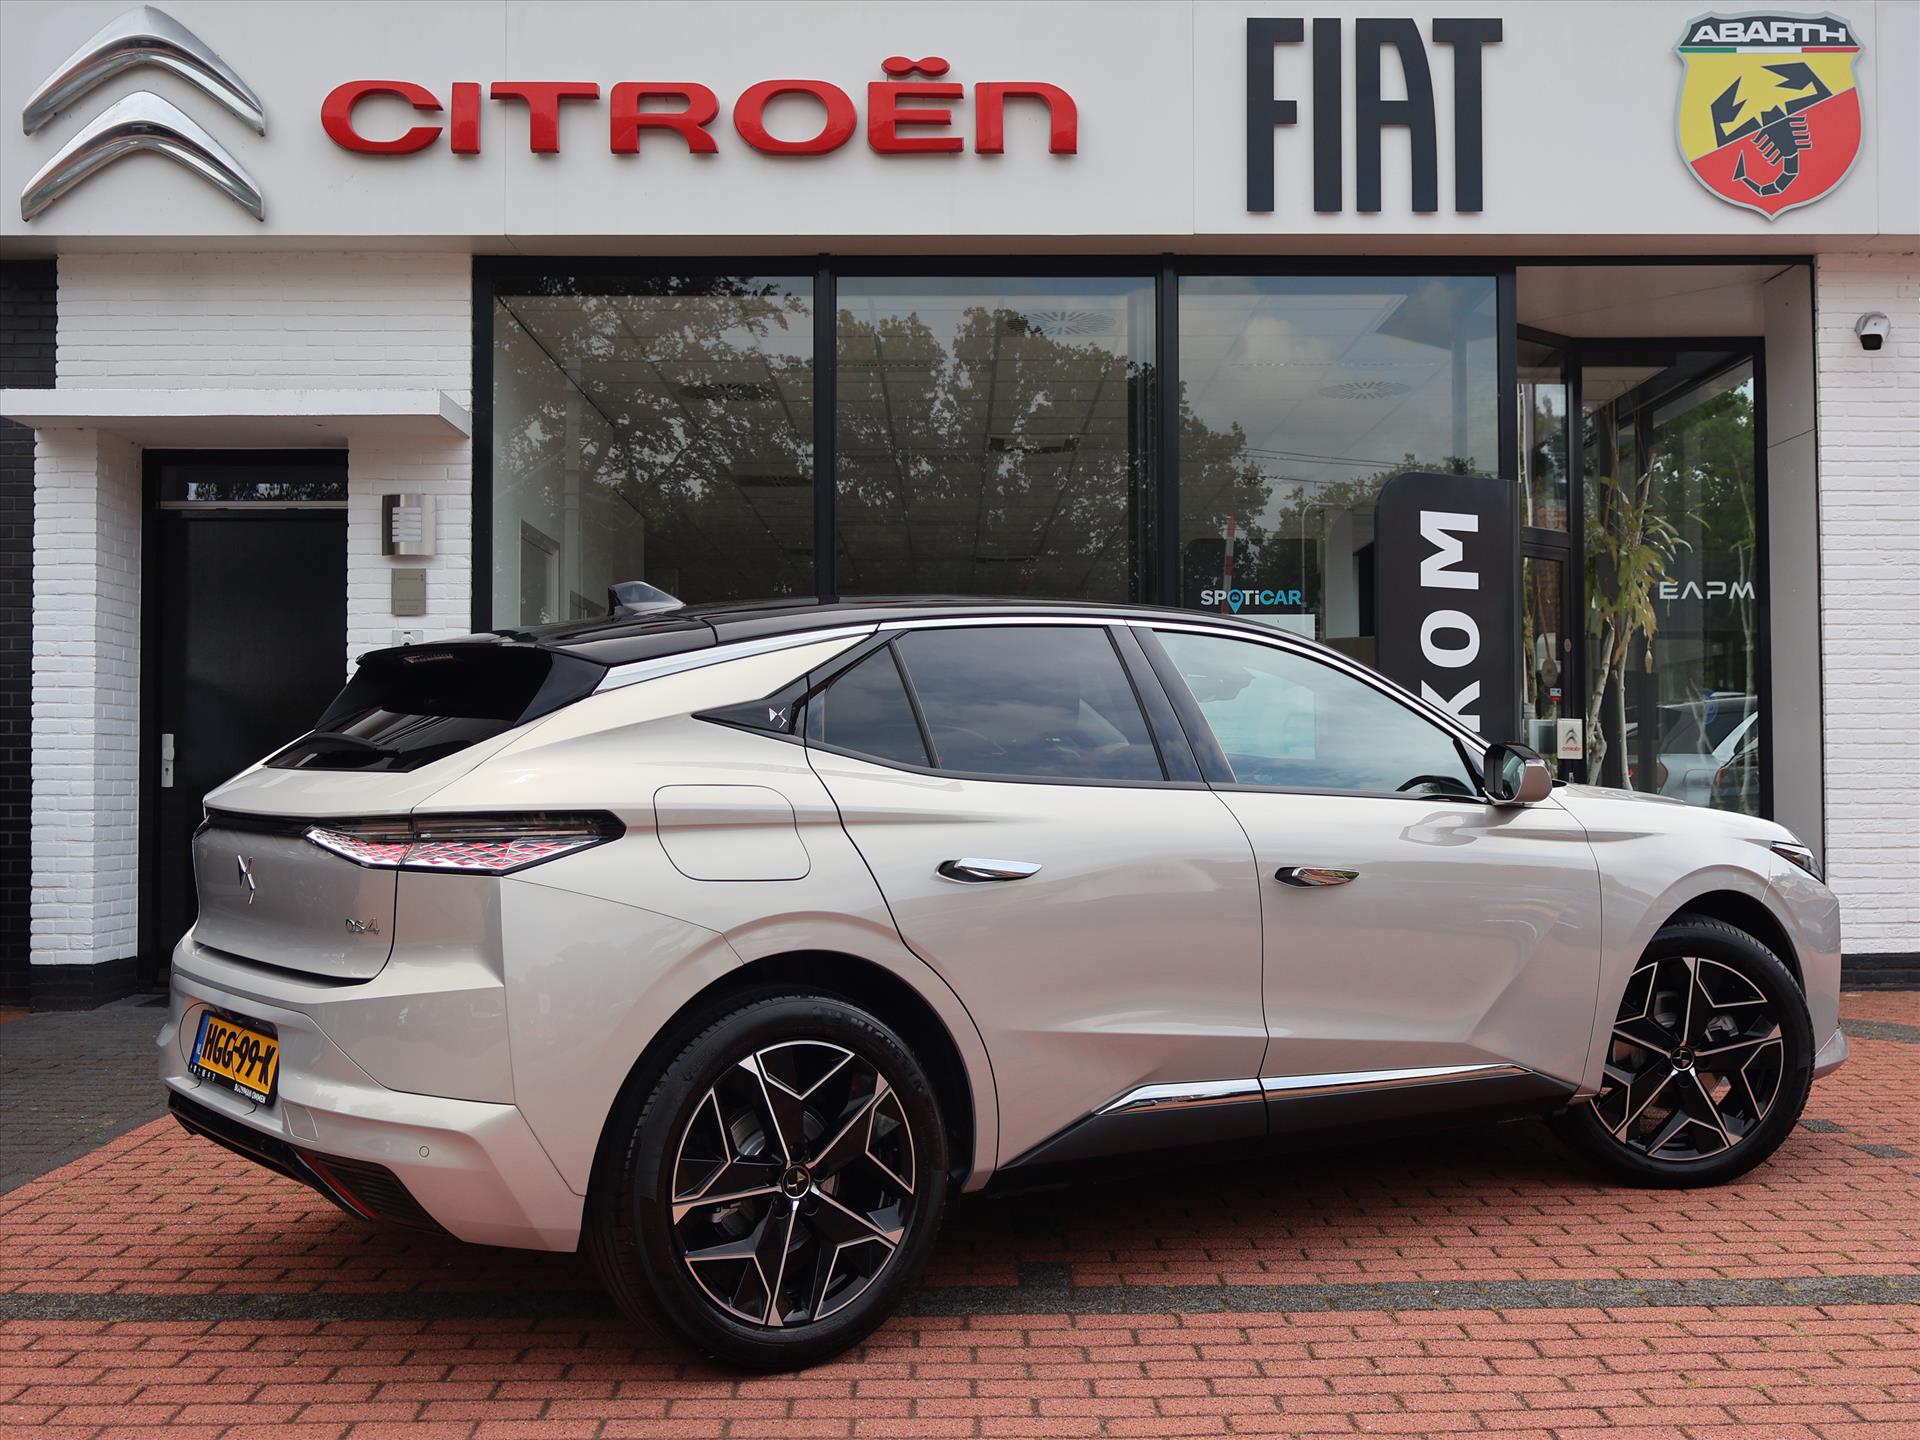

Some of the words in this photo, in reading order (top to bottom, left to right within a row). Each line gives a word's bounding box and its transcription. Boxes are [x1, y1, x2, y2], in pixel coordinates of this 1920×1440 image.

[1691, 21, 1847, 43] ABARTH
[320, 56, 1078, 156] CITROËN
[1246, 17, 1503, 213] FIAT
[1419, 510, 1481, 733] KOM
[202, 1023, 277, 1087] HGG-99-K
